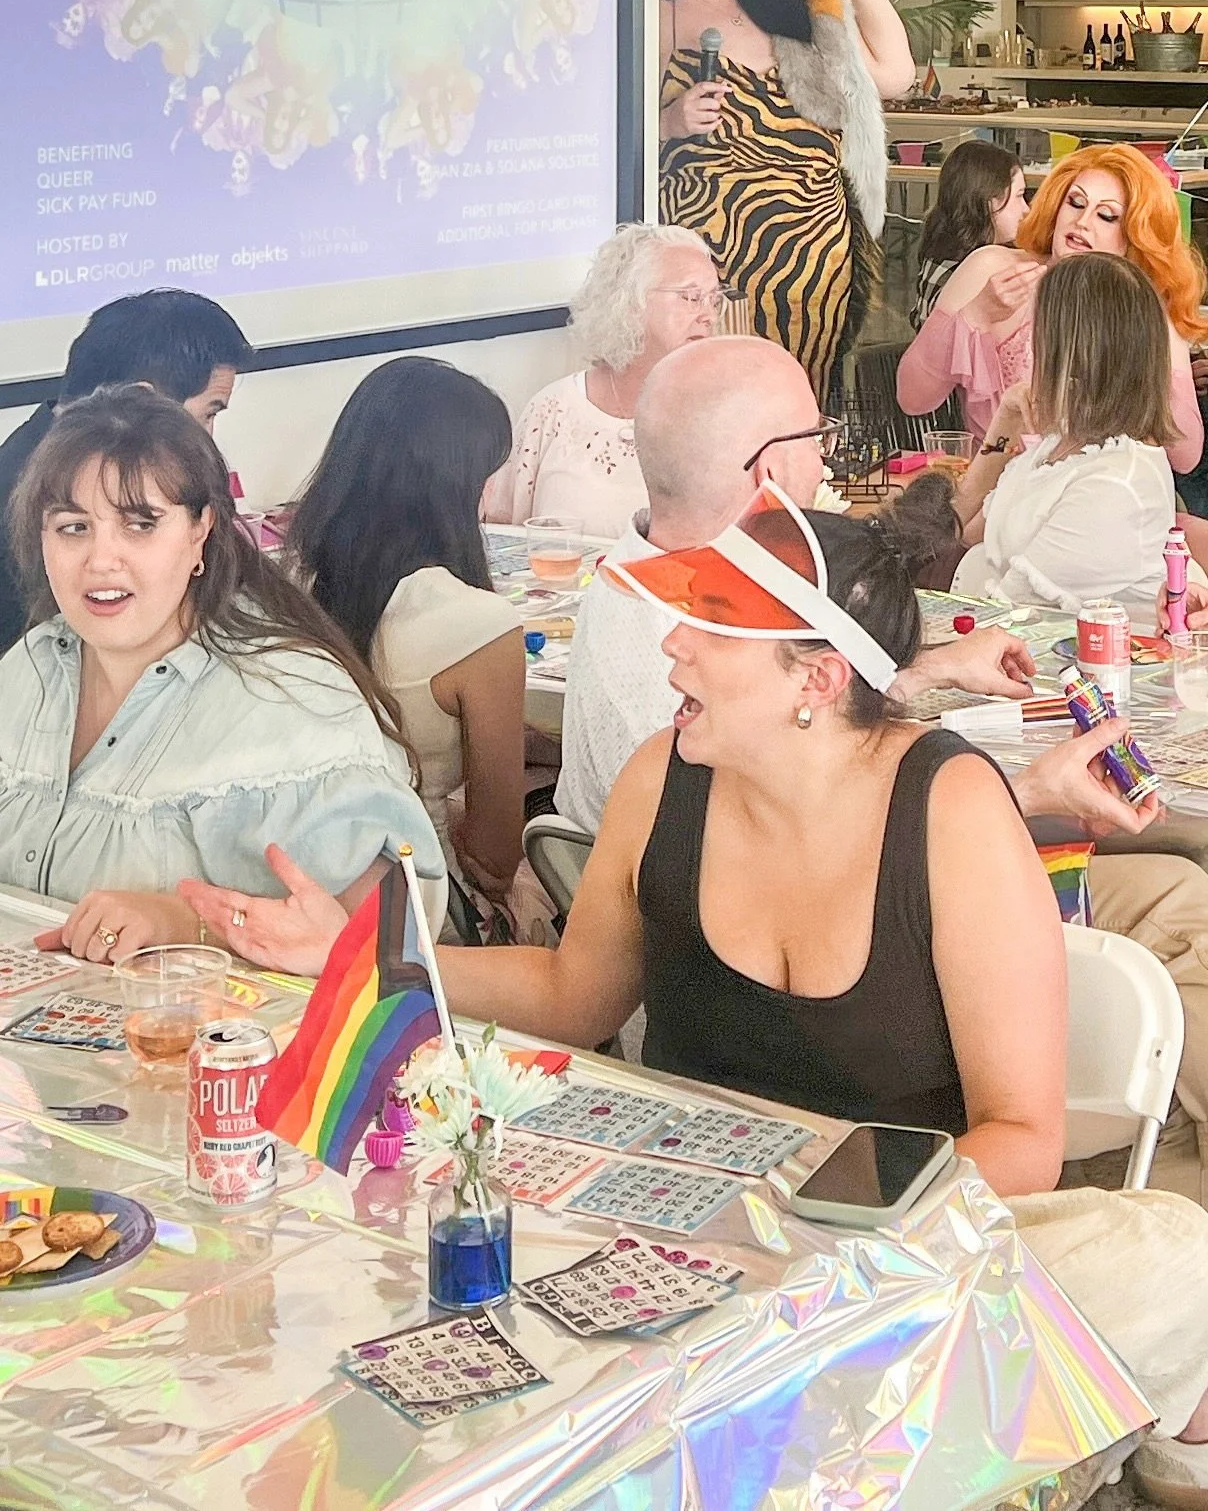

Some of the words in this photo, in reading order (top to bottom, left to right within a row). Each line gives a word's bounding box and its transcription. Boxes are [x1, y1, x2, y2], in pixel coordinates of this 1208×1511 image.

[37, 142, 133, 165] BENEFITING
[37, 170, 94, 190] QUEER
[36, 196, 74, 215] SICK
[78, 193, 107, 211] PAY
[112, 190, 157, 209] FUND
[462, 203, 494, 220] FIRST
[36, 234, 103, 256] HOSTED
[108, 231, 129, 249] BY
[165, 252, 220, 273] matter
[231, 243, 289, 271] objekts
[199, 1074, 269, 1117] POLA
[610, 1260, 630, 1269] 67
[632, 1252, 650, 1264] 72
[638, 1280, 655, 1290] 44
[659, 1274, 680, 1286] 31
[385, 1345, 399, 1353] 6
[394, 1356, 413, 1366] 20
[406, 1336, 424, 1348] 13
[416, 1350, 436, 1360] 21
